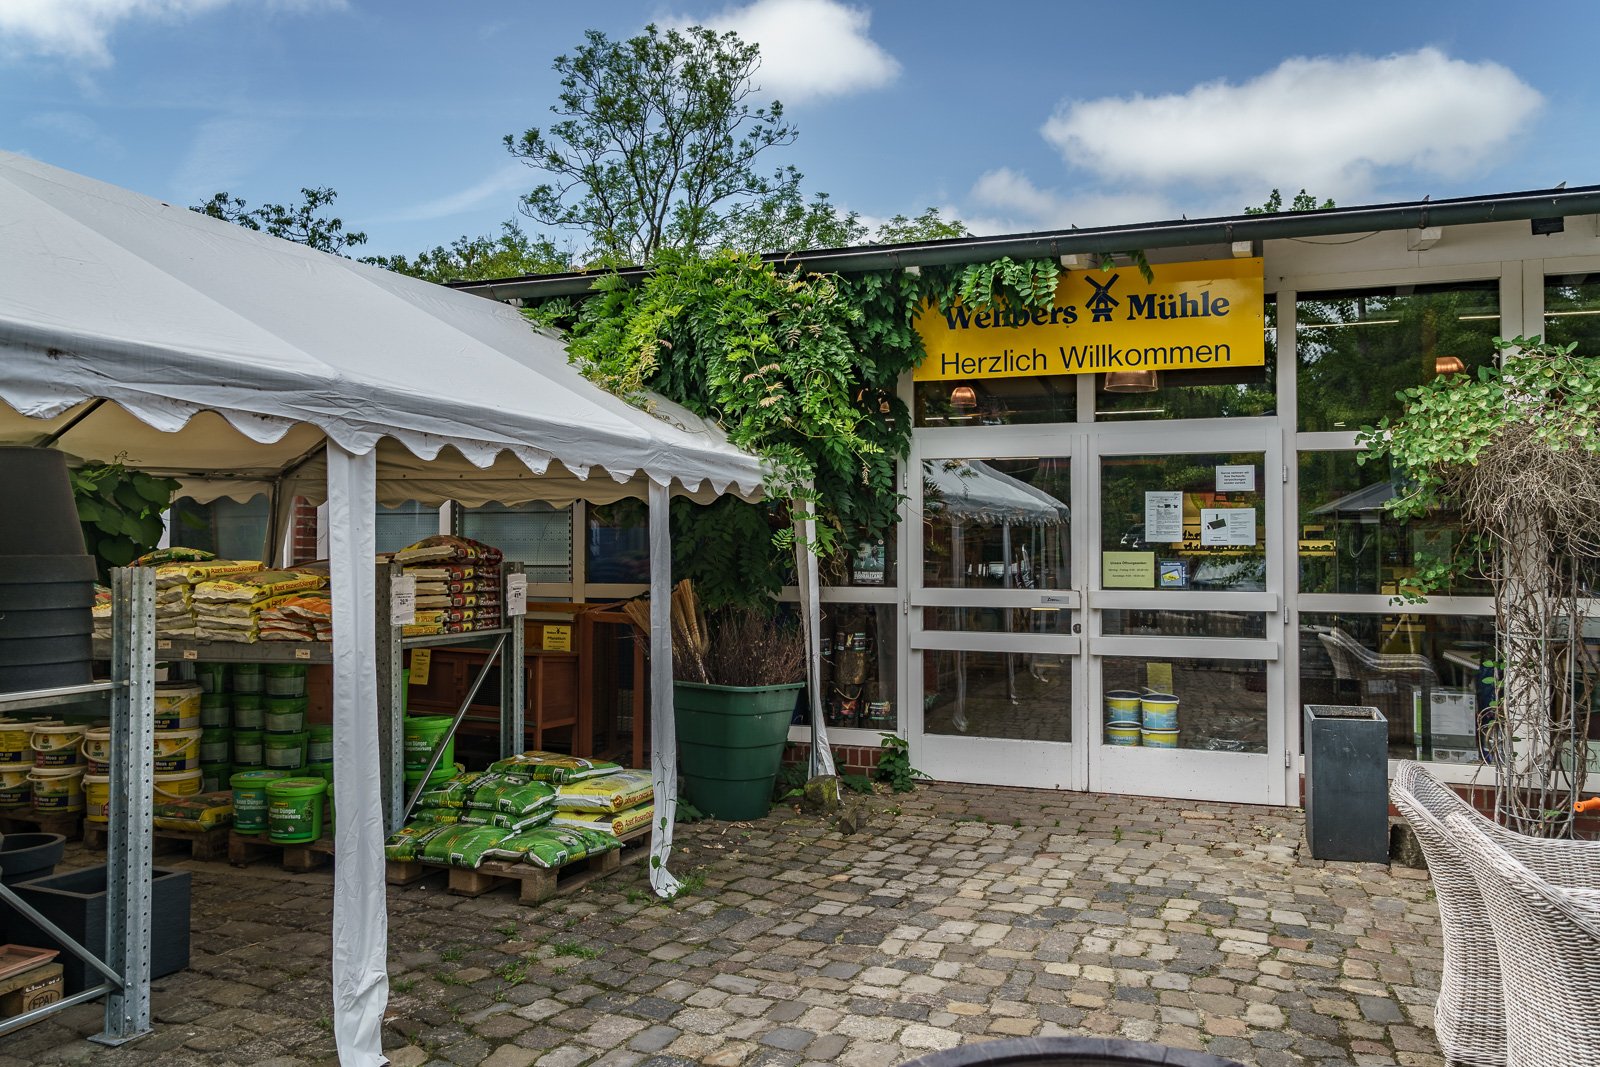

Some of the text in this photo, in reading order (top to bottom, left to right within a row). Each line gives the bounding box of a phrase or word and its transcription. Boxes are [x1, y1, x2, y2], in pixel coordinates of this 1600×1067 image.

[1127, 290, 1230, 321] Mühle
[941, 344, 1231, 376] Herzlich Willkommen
[447, 800, 464, 808] COMPO
[440, 815, 459, 823] COMPO
[33, 993, 54, 1009] EPAL
